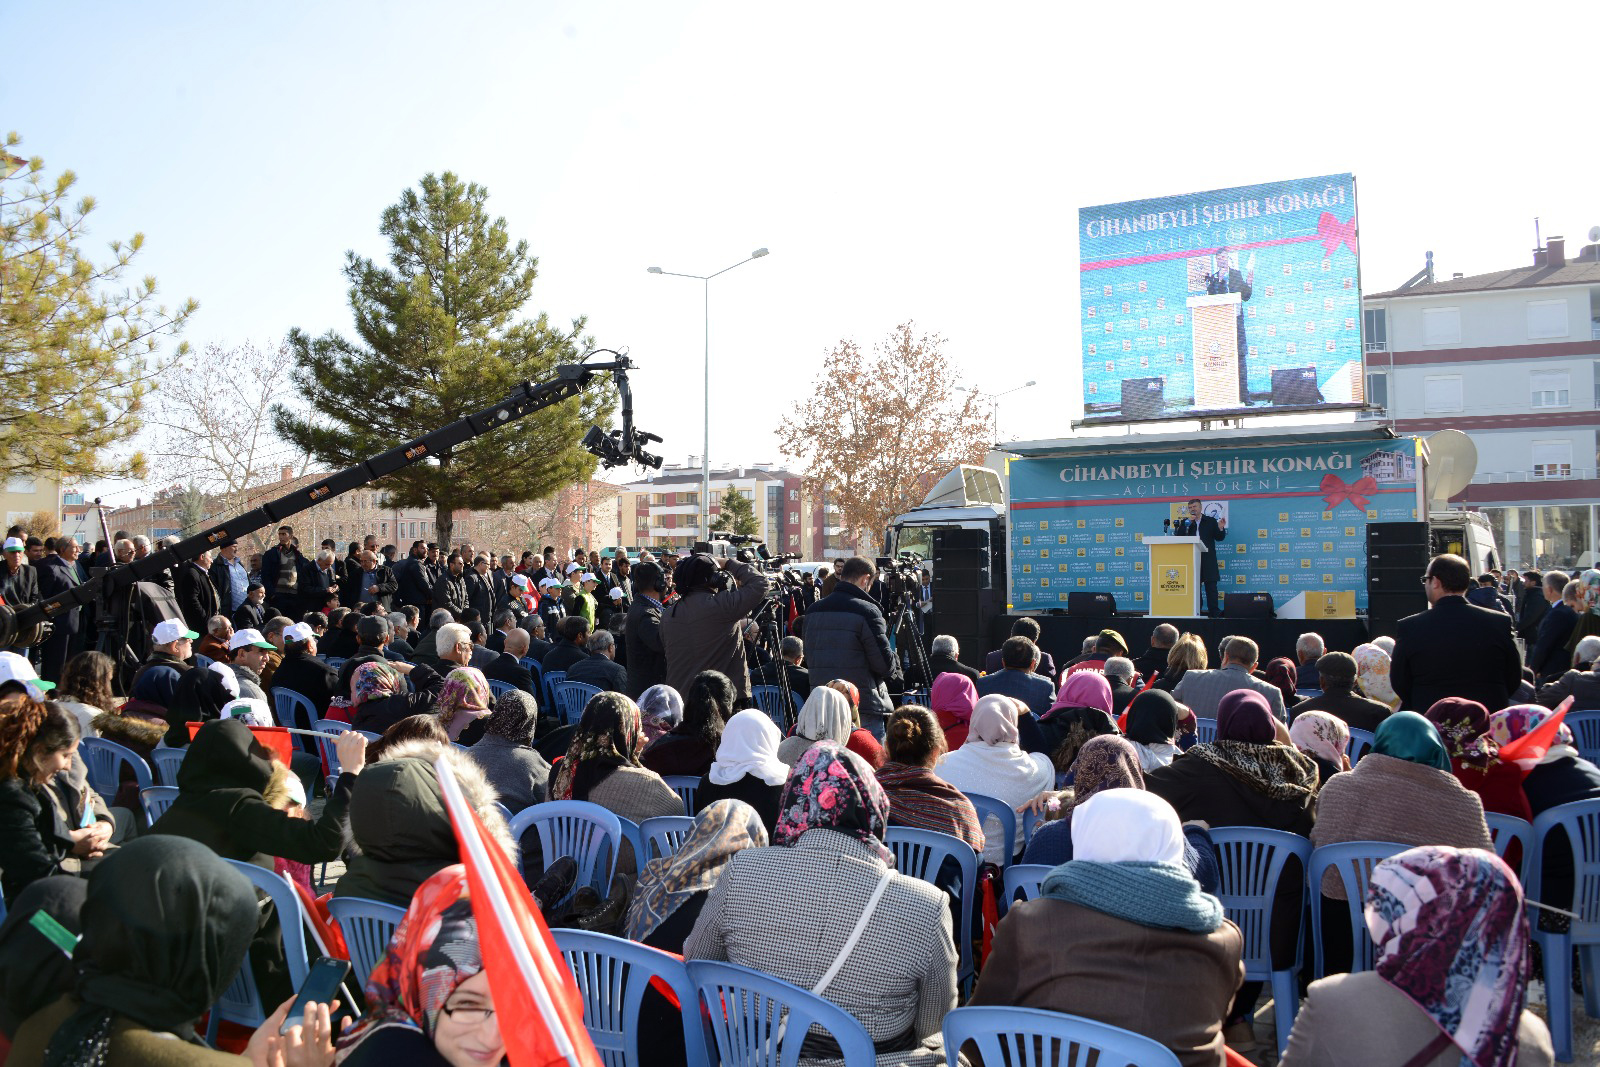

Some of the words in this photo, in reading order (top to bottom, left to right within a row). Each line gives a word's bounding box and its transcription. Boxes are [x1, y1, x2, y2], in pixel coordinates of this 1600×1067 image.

[1086, 203, 1199, 239] CİHANBEYLİ
[1202, 197, 1260, 229] ŞEHİR
[1264, 184, 1345, 215] KONAĞI
[1059, 459, 1185, 483] CİHANBEYLİ
[1190, 456, 1258, 480] ŞEHİR
[1262, 451, 1352, 473] KONAĞI
[1123, 483, 1189, 497] AÇILIŞ
[1201, 475, 1281, 492] TÖRENİ
